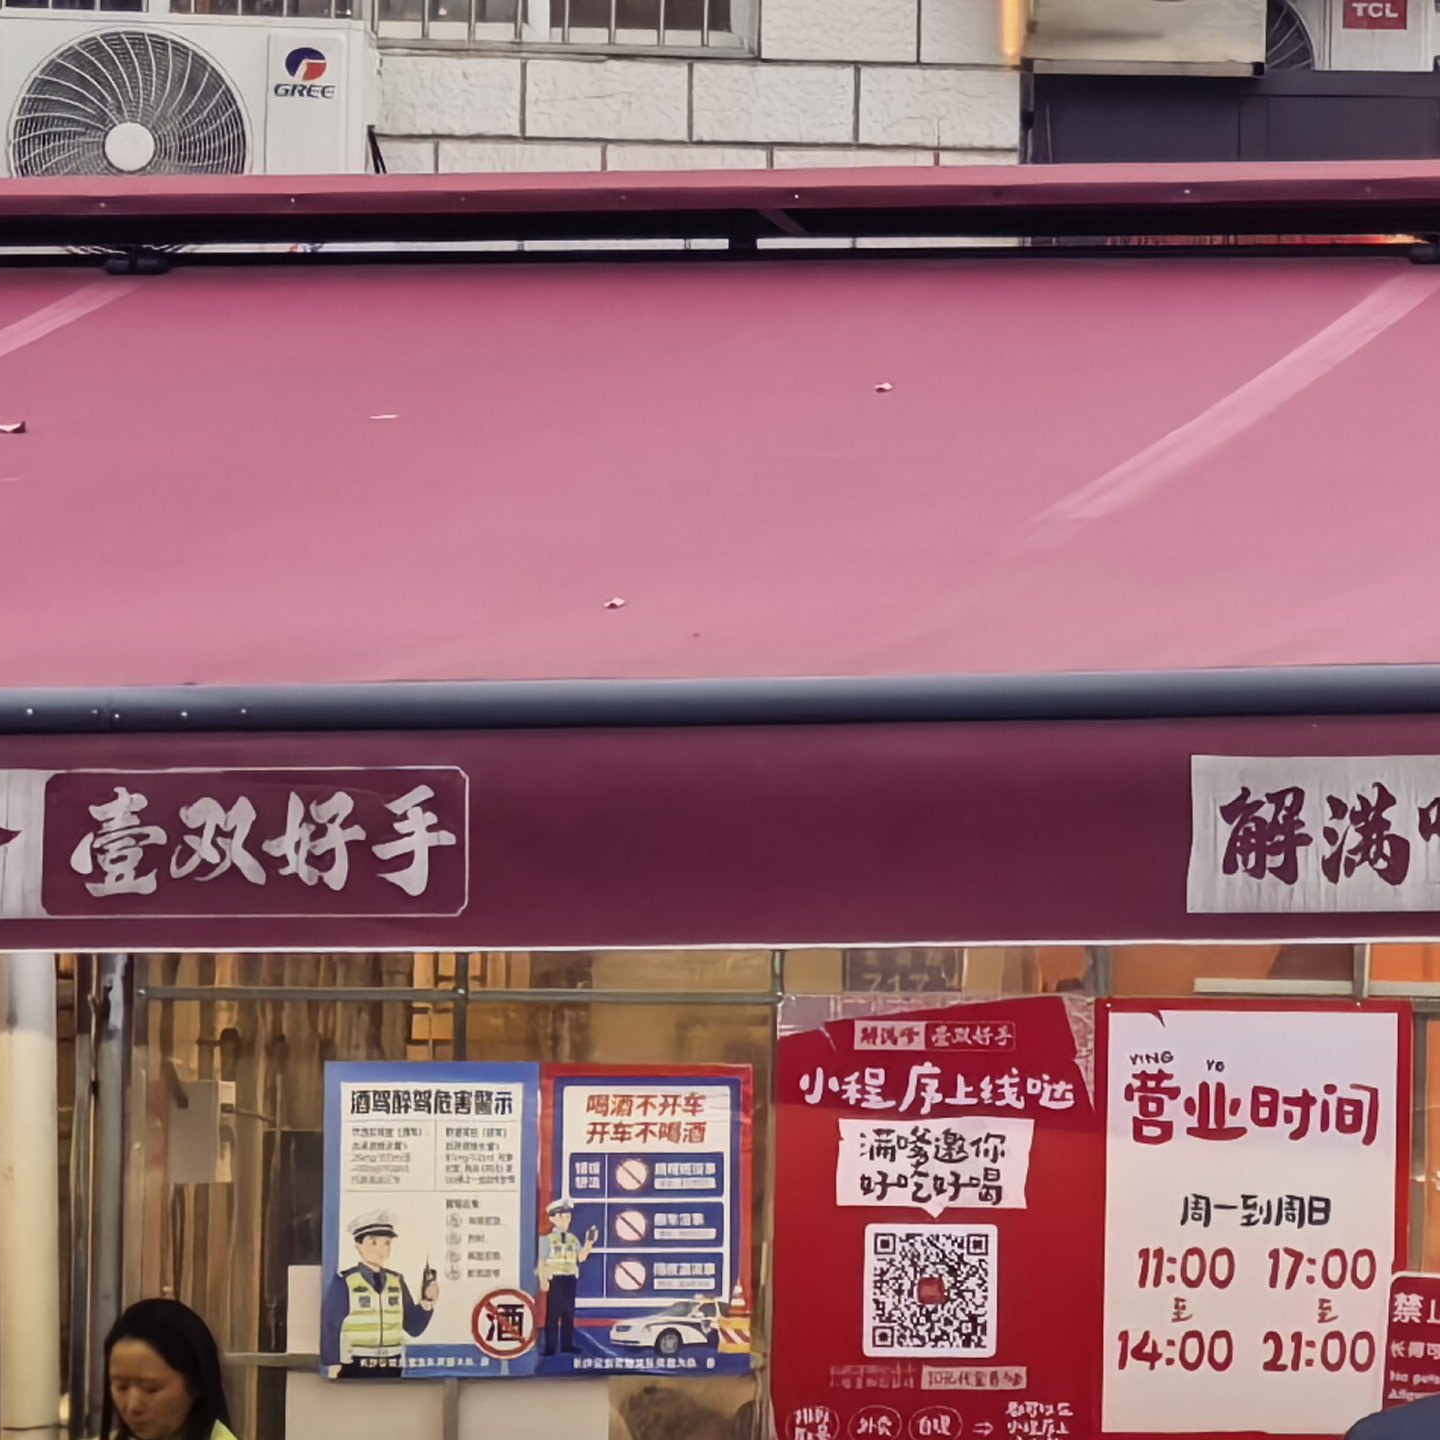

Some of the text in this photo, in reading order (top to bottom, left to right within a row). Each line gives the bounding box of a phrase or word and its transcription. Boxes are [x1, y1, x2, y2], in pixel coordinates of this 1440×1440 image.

[1352, 2, 1399, 19] TCL
[274, 83, 336, 99] GREE
[68, 784, 457, 898] 壹双好手
[585, 1092, 706, 1117] 喝酒不开车
[799, 1061, 1075, 1115] 小程序上线哒
[1124, 1068, 1380, 1146] 营业时间
[585, 1120, 707, 1145] 开车不喝酒
[859, 1160, 1003, 1206] 好吃好喝
[1180, 1193, 1331, 1228] 周一到周日
[1137, 1246, 1377, 1291] 11:00 17:00
[1117, 1329, 1376, 1373] 14:00 21:00
